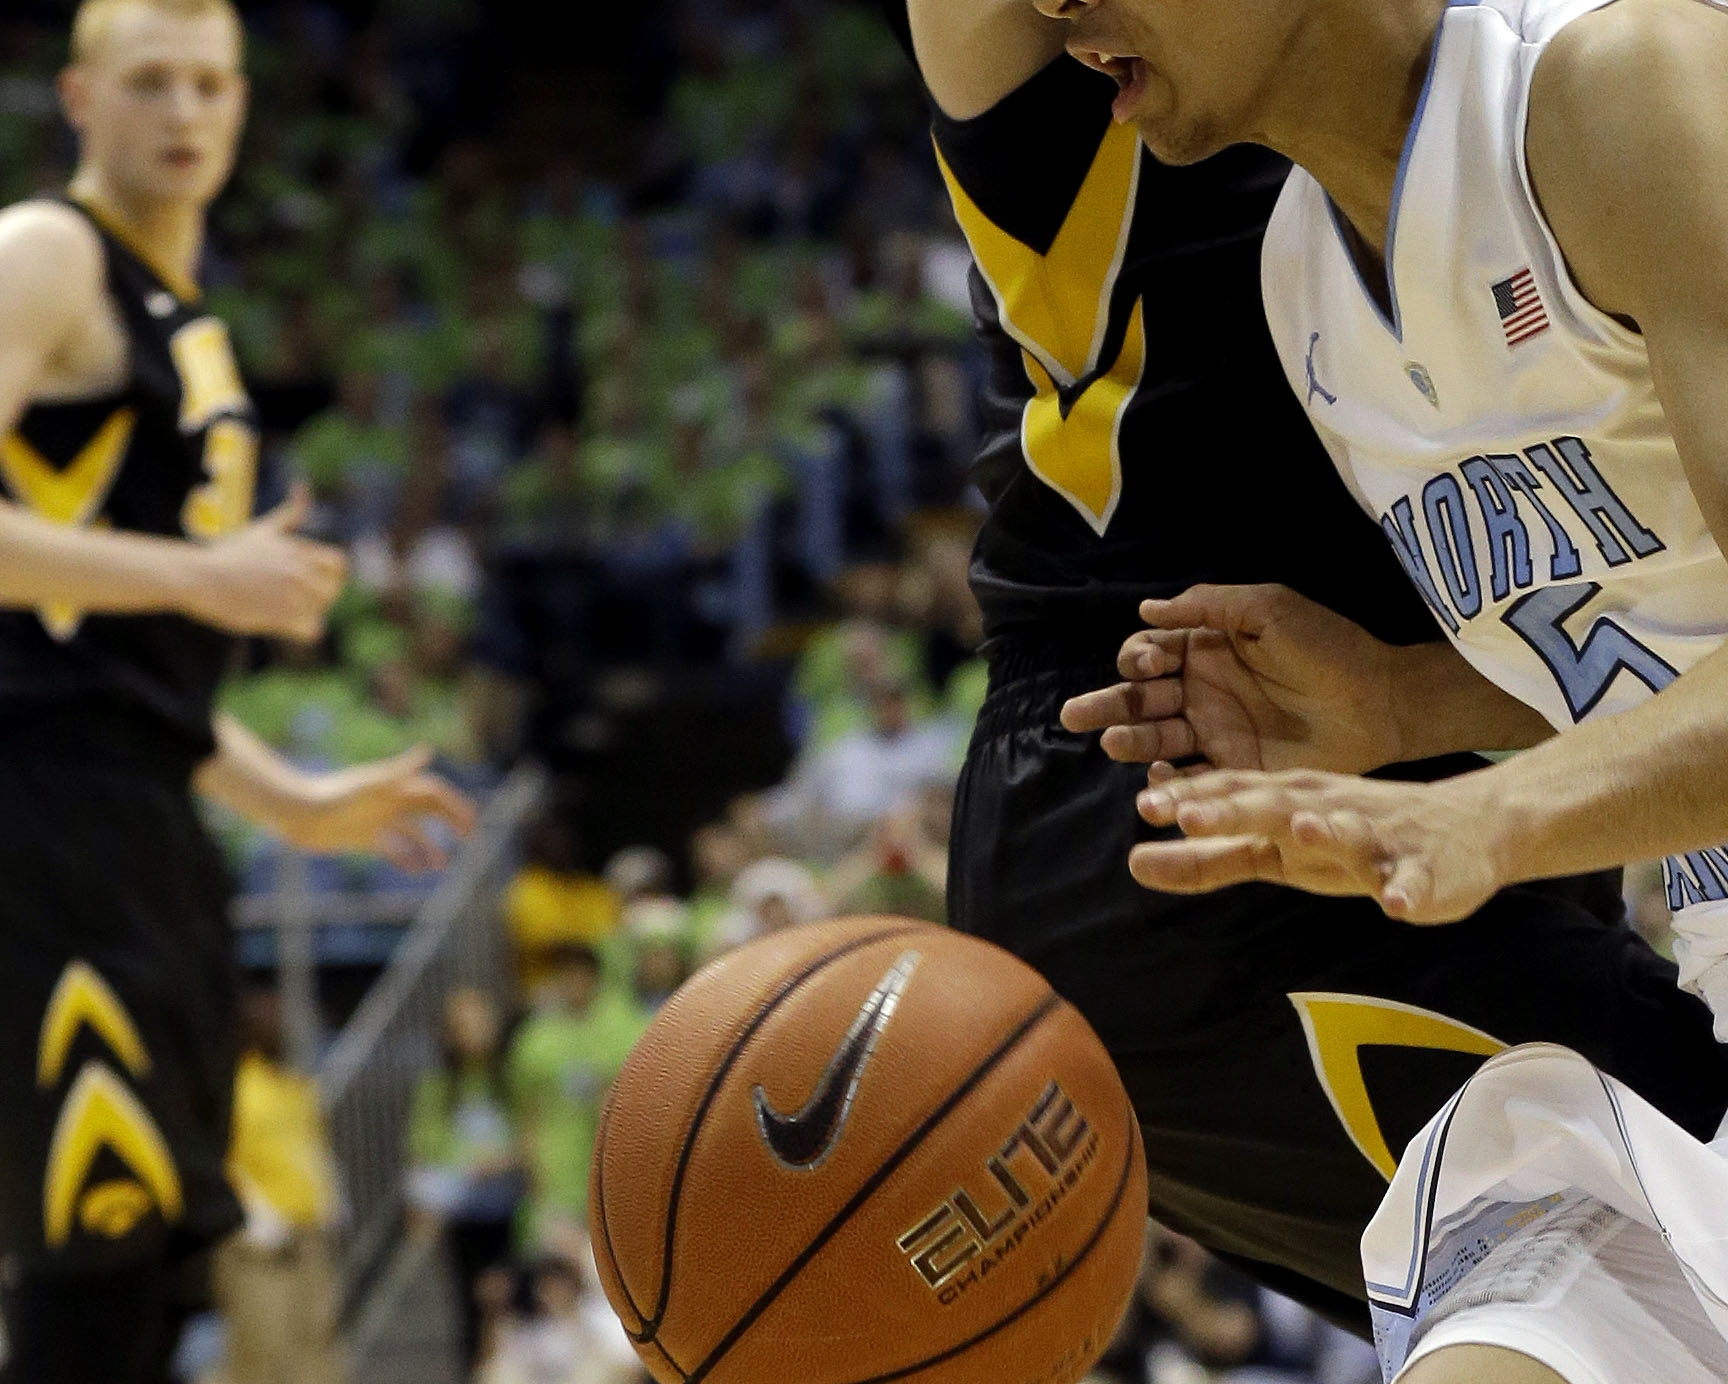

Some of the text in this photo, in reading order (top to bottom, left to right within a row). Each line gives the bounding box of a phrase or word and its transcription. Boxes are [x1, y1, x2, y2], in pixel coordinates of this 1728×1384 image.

[1380, 435, 1667, 635] NORTH
[1499, 581, 1684, 724] 5
[896, 1078, 1092, 1290] ELITE
[937, 1131, 1102, 1306] CHAMPIONSHIP
